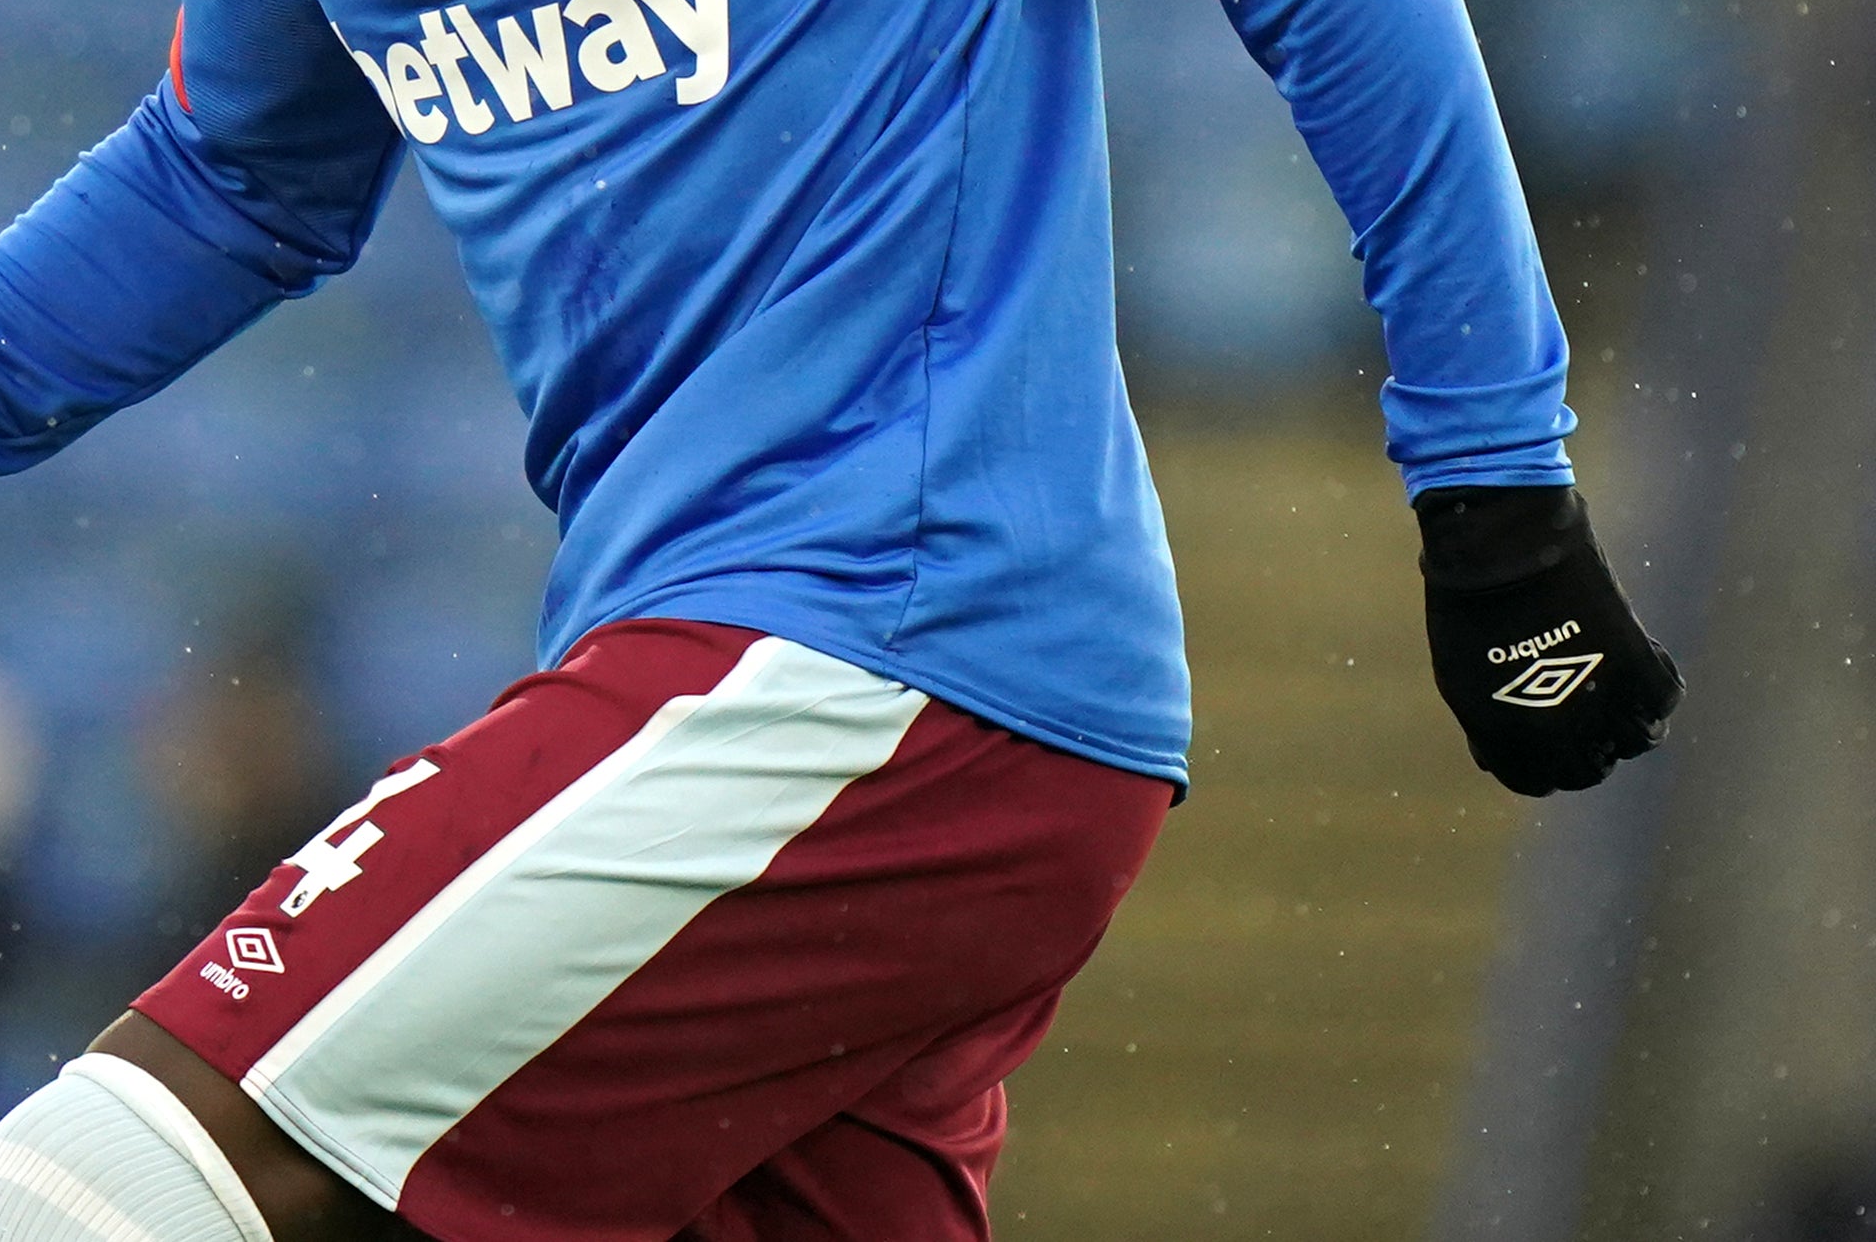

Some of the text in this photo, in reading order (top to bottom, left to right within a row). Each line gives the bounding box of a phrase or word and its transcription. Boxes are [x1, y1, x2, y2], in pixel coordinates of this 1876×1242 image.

[1487, 620, 1582, 665] umbro
[279, 757, 442, 919] 4
[199, 961, 250, 1000] umbro
